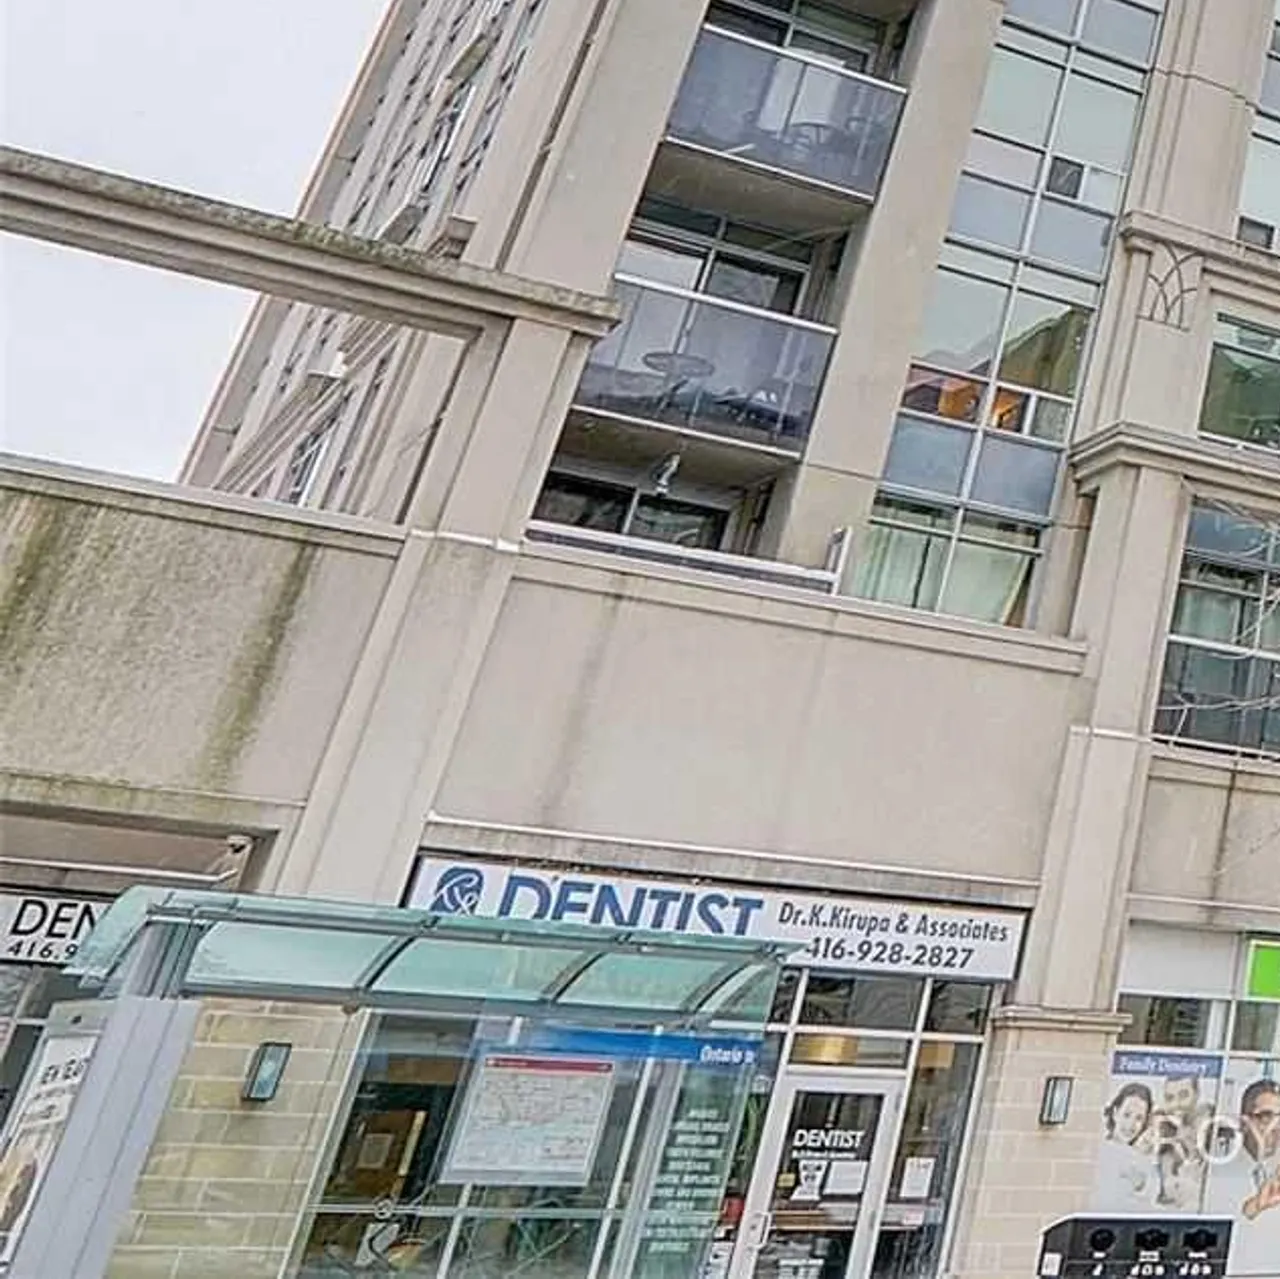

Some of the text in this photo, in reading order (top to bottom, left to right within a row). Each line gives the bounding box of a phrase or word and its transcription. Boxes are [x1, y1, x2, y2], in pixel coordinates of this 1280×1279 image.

[10, 899, 97, 940] DEN
[499, 875, 765, 936] DENTIST
[895, 912, 908, 935] &
[915, 913, 1008, 942] Associates
[7, 939, 79, 960] 416.9
[805, 936, 975, 970] 416-928-2827
[792, 1129, 866, 1149] DENTIST
